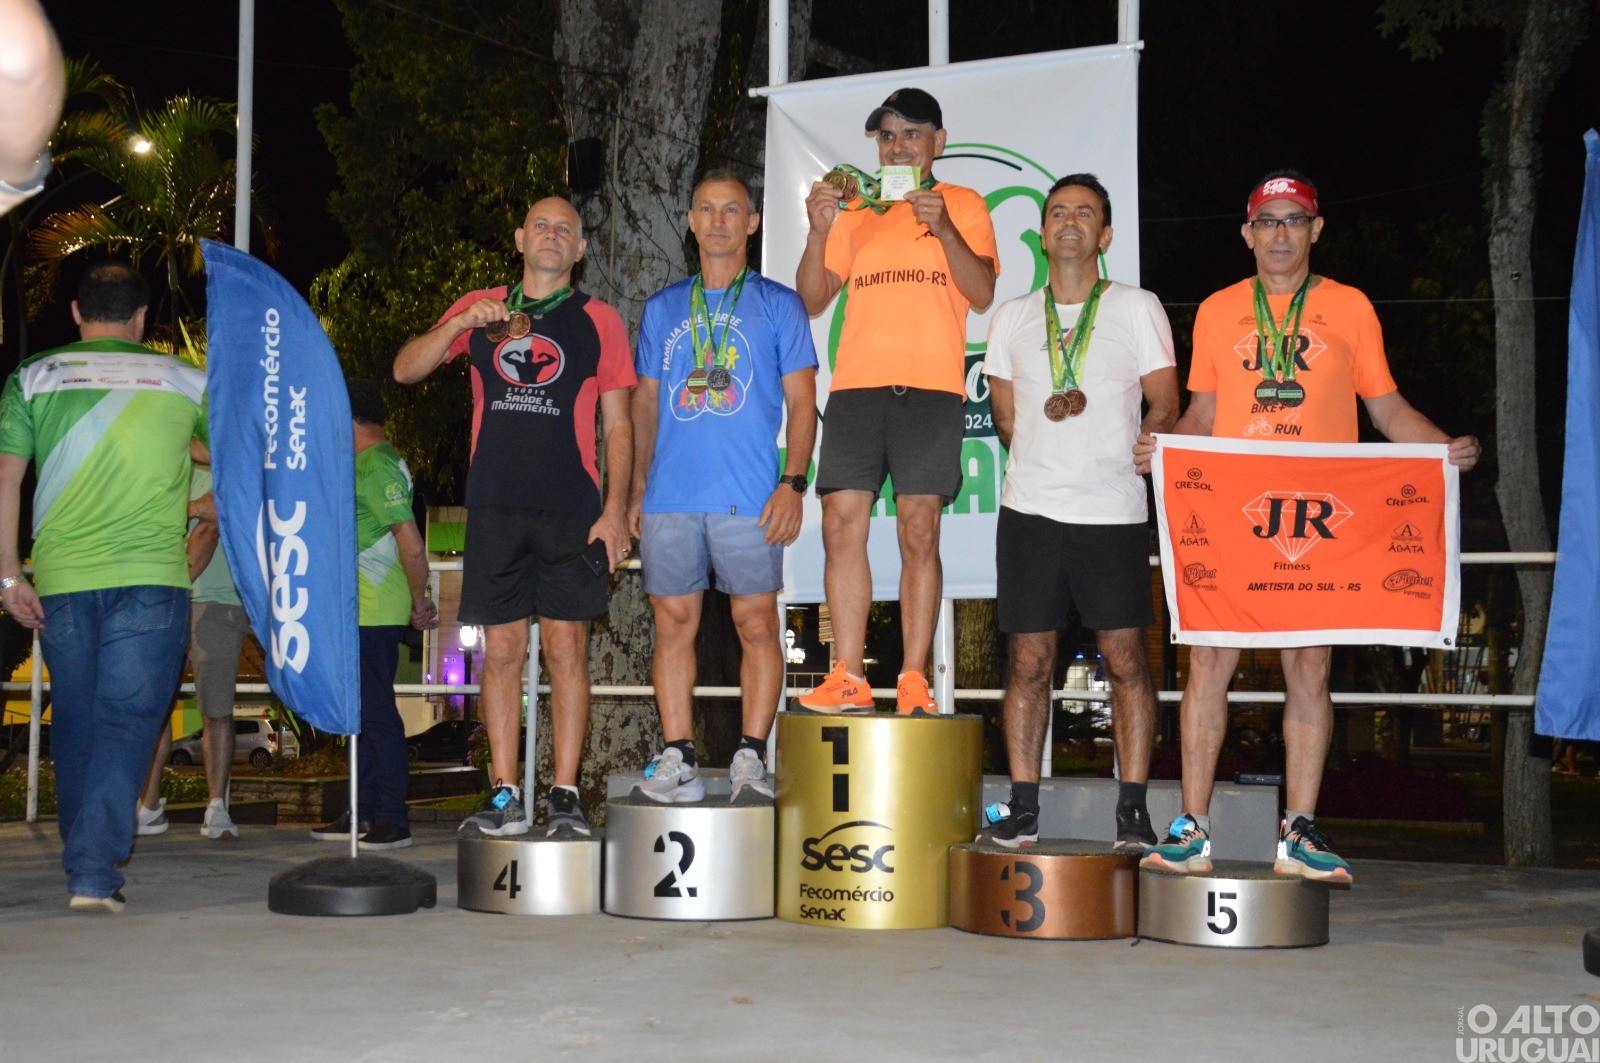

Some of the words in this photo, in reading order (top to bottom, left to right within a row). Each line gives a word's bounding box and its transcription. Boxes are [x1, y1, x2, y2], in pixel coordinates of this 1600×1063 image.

[287, 386, 307, 471] Senac
[1274, 423, 1302, 436] RUN
[1175, 481, 1214, 491] CRESOL
[1386, 496, 1430, 507] CRESOL
[1252, 497, 1337, 539] JR
[1179, 535, 1210, 547] ÁGATA
[1388, 541, 1425, 554] ÁGATA
[1273, 561, 1311, 571] Fitness
[1247, 582, 1295, 592] AMETISTA
[1298, 582, 1313, 592] DO
[1316, 582, 1336, 592] SUL
[1347, 582, 1362, 592] RS
[842, 687, 858, 699] FILA
[821, 726, 849, 812] 1
[653, 831, 698, 897] 2
[492, 859, 522, 899] 4
[799, 882, 894, 902] Fecomércio
[1000, 860, 1046, 932] 3
[800, 904, 846, 922] Senac
[1206, 890, 1238, 935] 5
